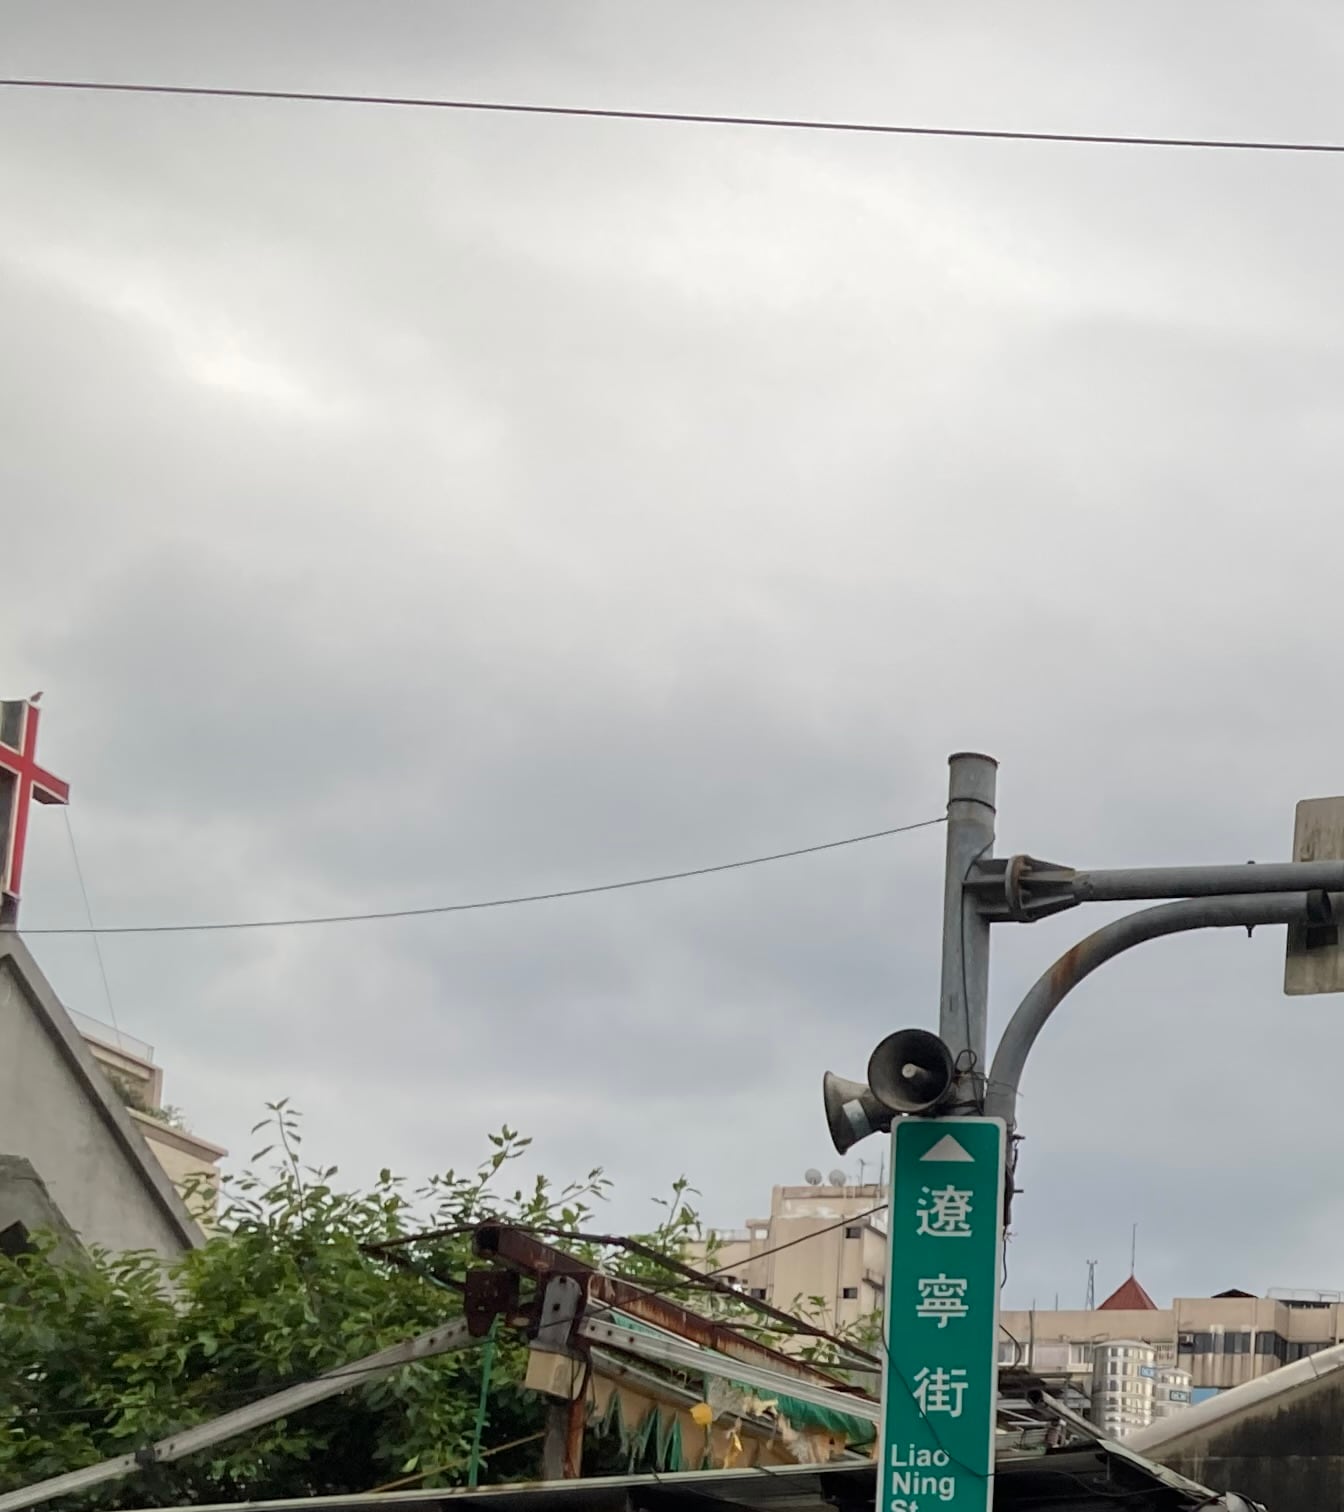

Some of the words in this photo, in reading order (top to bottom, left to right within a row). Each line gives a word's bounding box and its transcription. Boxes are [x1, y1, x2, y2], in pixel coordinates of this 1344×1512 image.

[912, 1185, 974, 1418] 遼寧街
[890, 1444, 950, 1467] Liao
[891, 1470, 956, 1500] Ning
